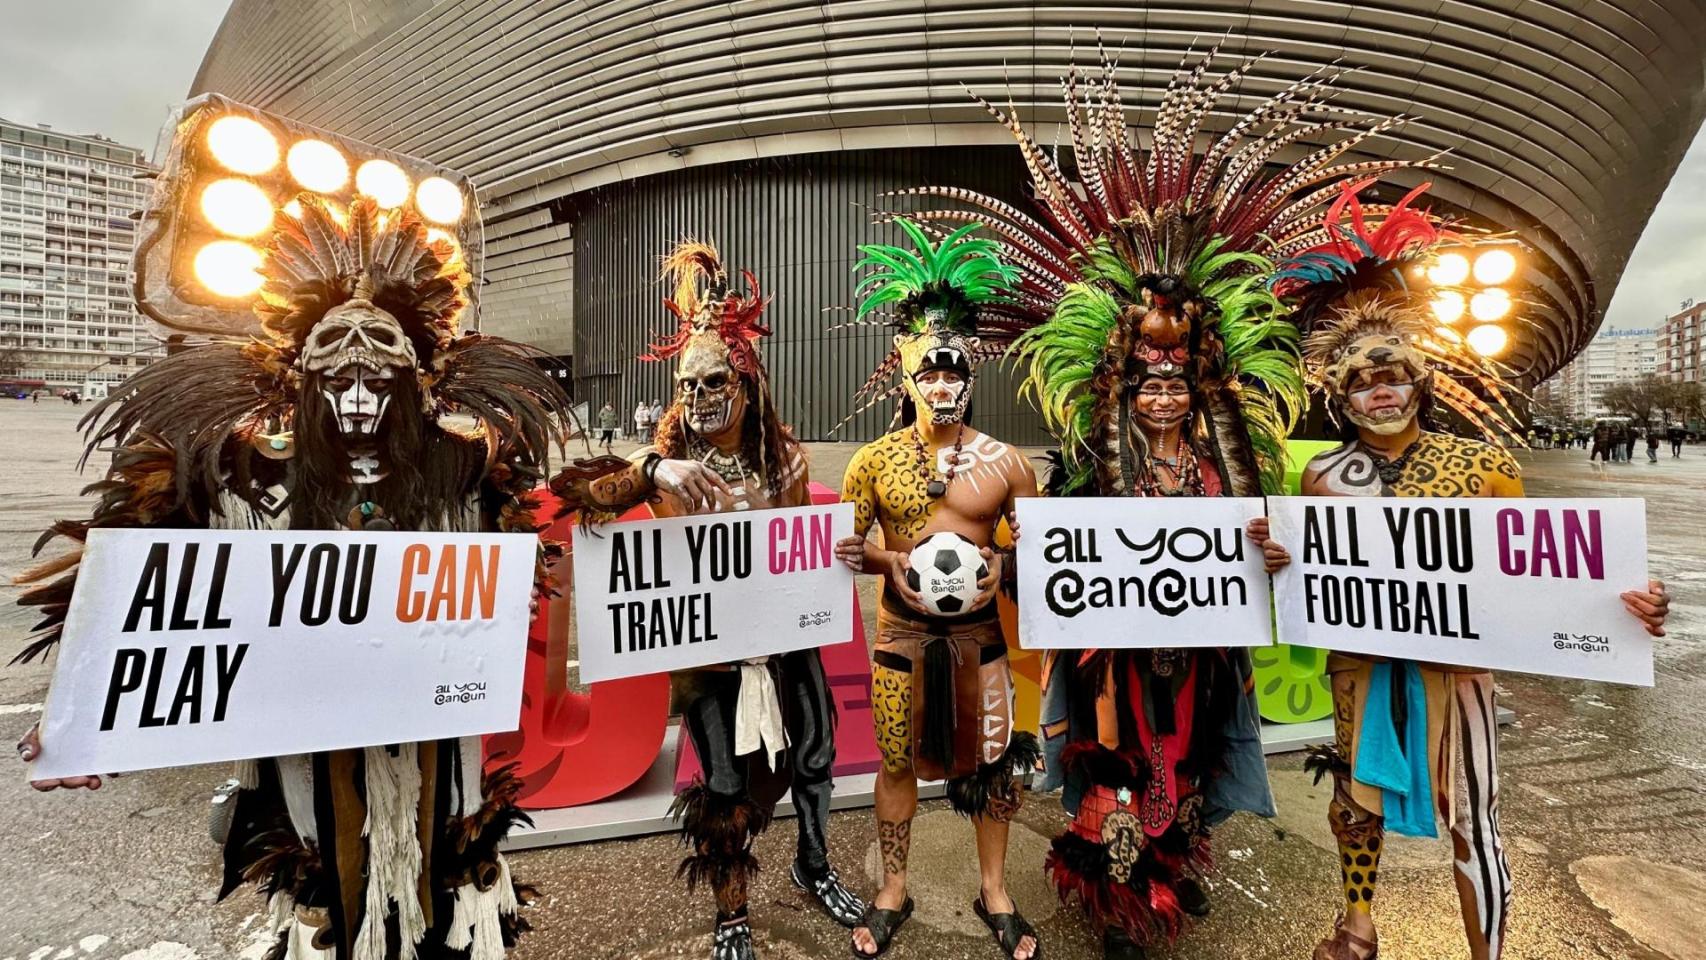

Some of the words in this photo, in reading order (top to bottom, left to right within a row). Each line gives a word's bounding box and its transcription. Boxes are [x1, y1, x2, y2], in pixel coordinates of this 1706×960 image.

[609, 529, 670, 593] ALL
[685, 521, 751, 584] YOU
[769, 514, 831, 574] CAN
[1115, 528, 1244, 564] you
[1303, 506, 1369, 567] ALL
[1383, 507, 1473, 573] YOU
[1498, 509, 1603, 579] CAN
[122, 543, 232, 632] ALL
[269, 544, 377, 627] YOU
[397, 544, 499, 622] CAN
[608, 593, 717, 653] TRAVEL
[1304, 574, 1479, 640] FOOTBALL
[100, 644, 249, 731] PLAY
